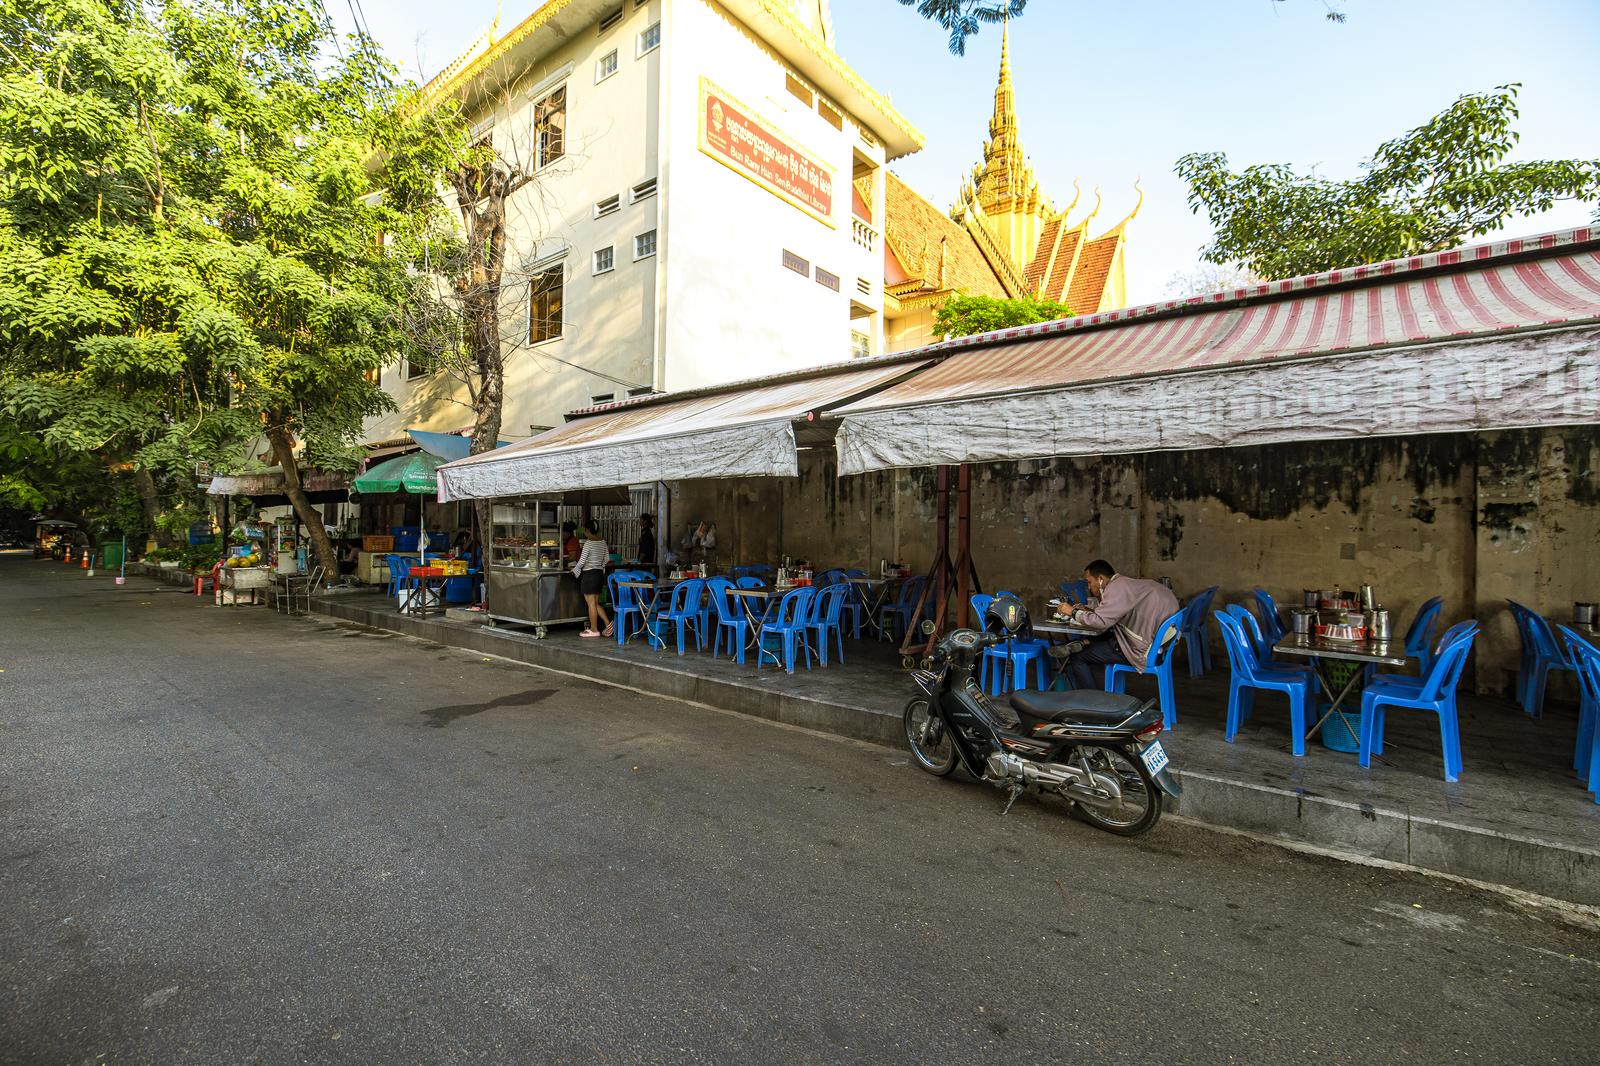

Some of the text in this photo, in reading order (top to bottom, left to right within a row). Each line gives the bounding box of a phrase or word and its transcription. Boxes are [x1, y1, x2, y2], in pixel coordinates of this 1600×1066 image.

[730, 146, 826, 214] Bun Rany Hun Sen Buddhist Library
